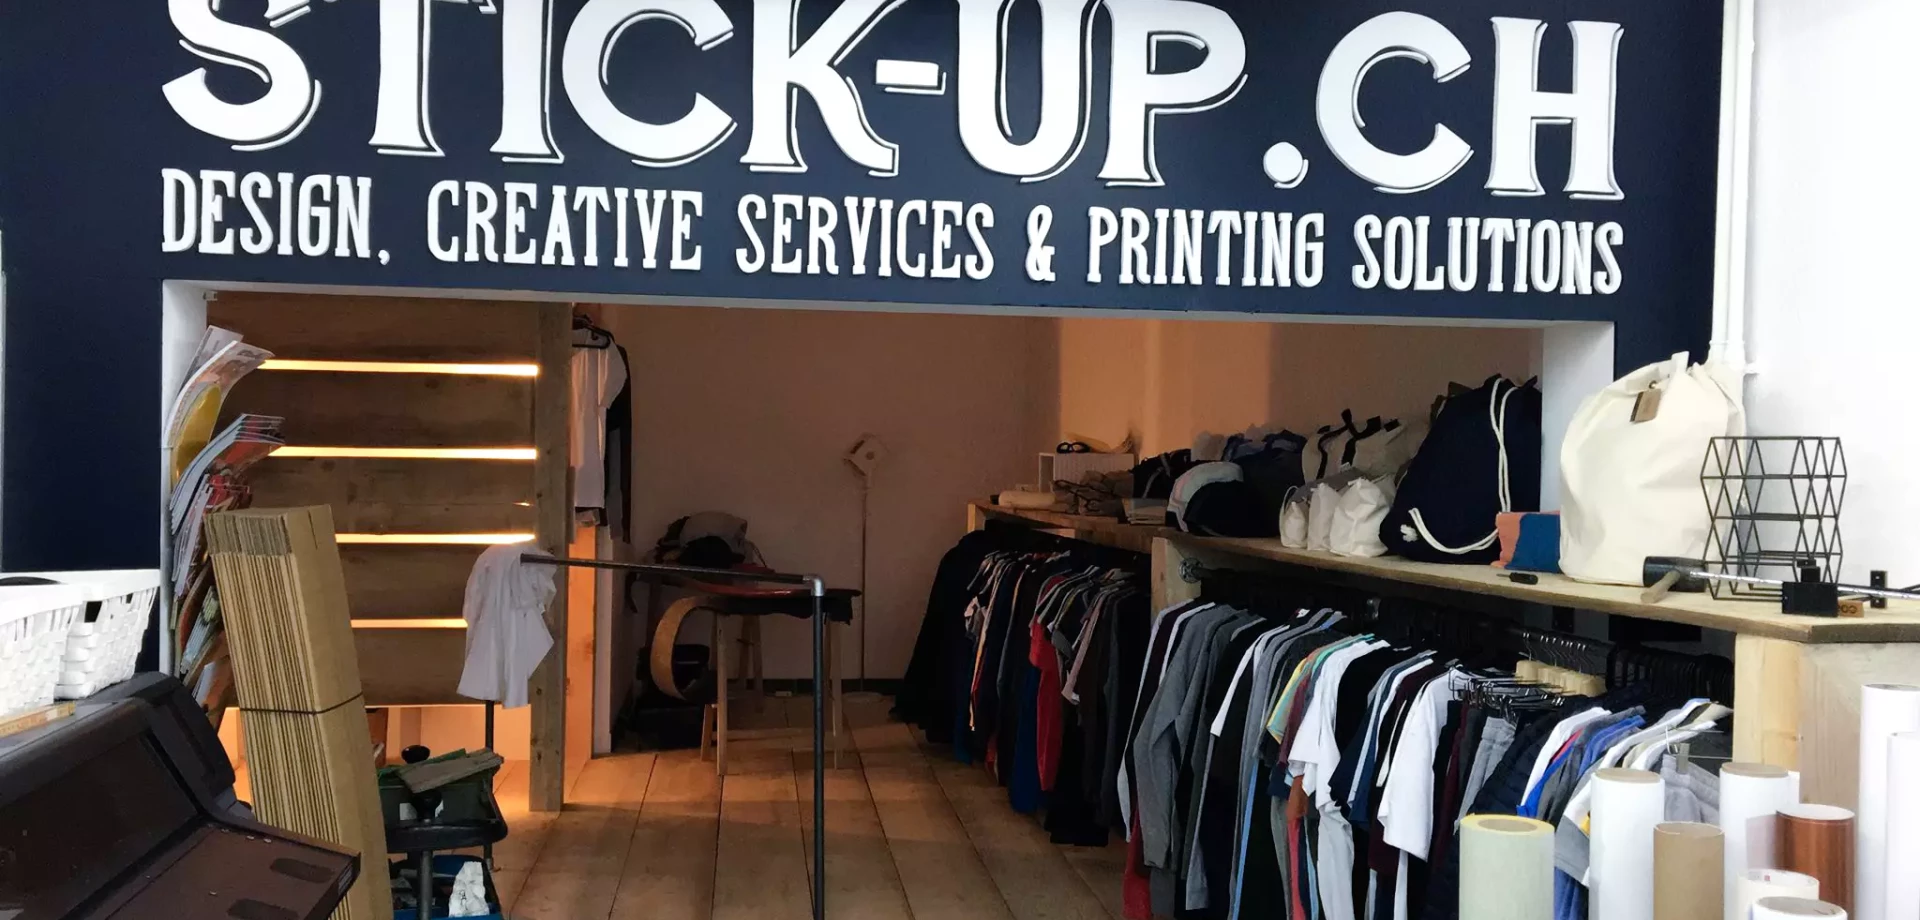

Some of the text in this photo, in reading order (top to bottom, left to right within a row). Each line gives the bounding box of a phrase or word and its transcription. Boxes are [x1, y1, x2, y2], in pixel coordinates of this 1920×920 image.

[162, 168, 1625, 295] DESIGN, CREATIVE SERVICES & PRINTING SOLUTIONS
